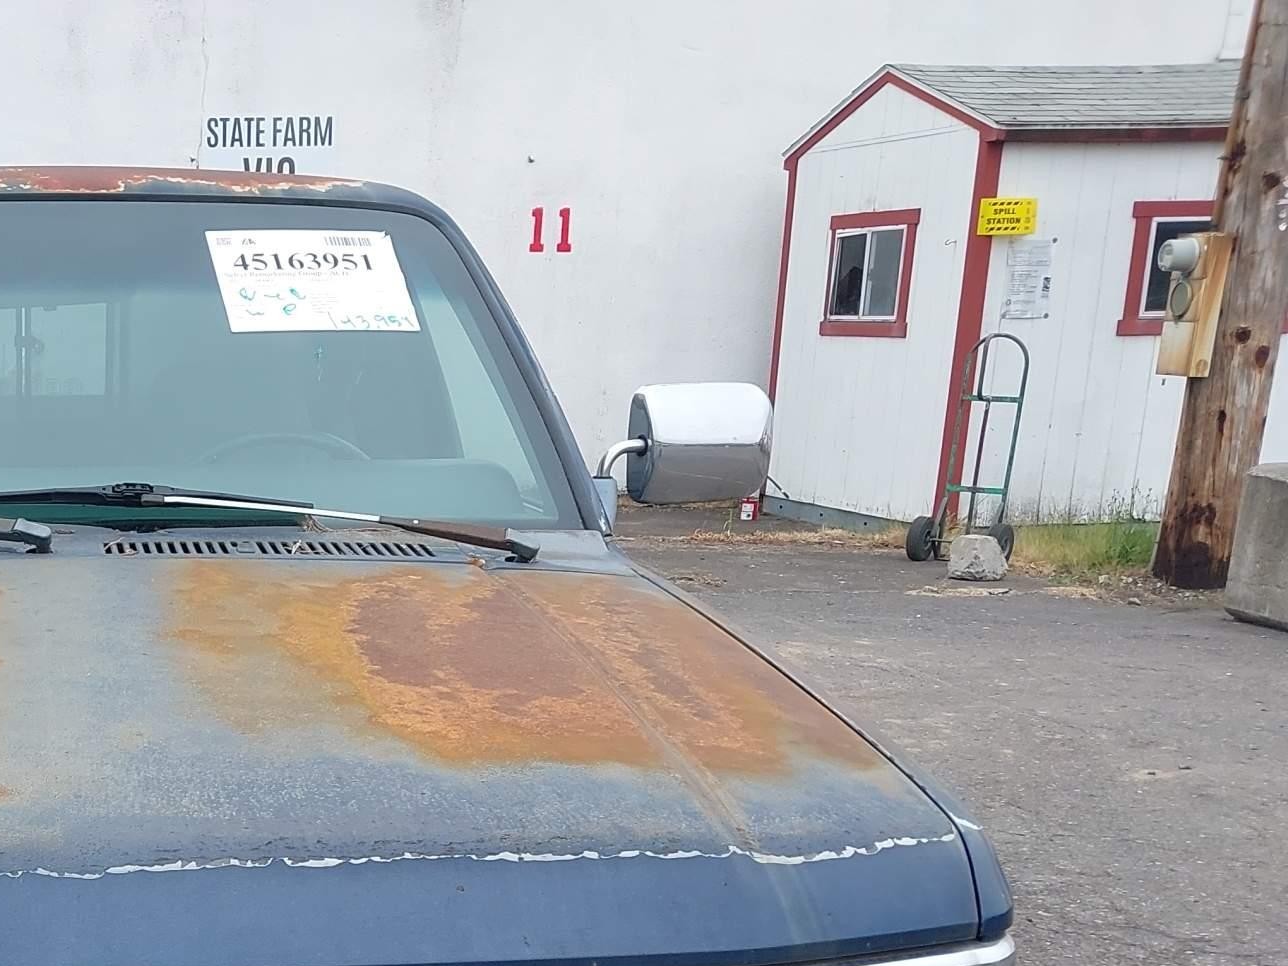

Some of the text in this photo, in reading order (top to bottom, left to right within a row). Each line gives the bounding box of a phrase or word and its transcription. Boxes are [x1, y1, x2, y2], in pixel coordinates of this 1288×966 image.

[206, 116, 333, 148] STATE FARM
[993, 207, 1017, 215] SPILL
[529, 207, 571, 252] 11
[986, 217, 1021, 225] STATION
[233, 253, 374, 271] 45163951
